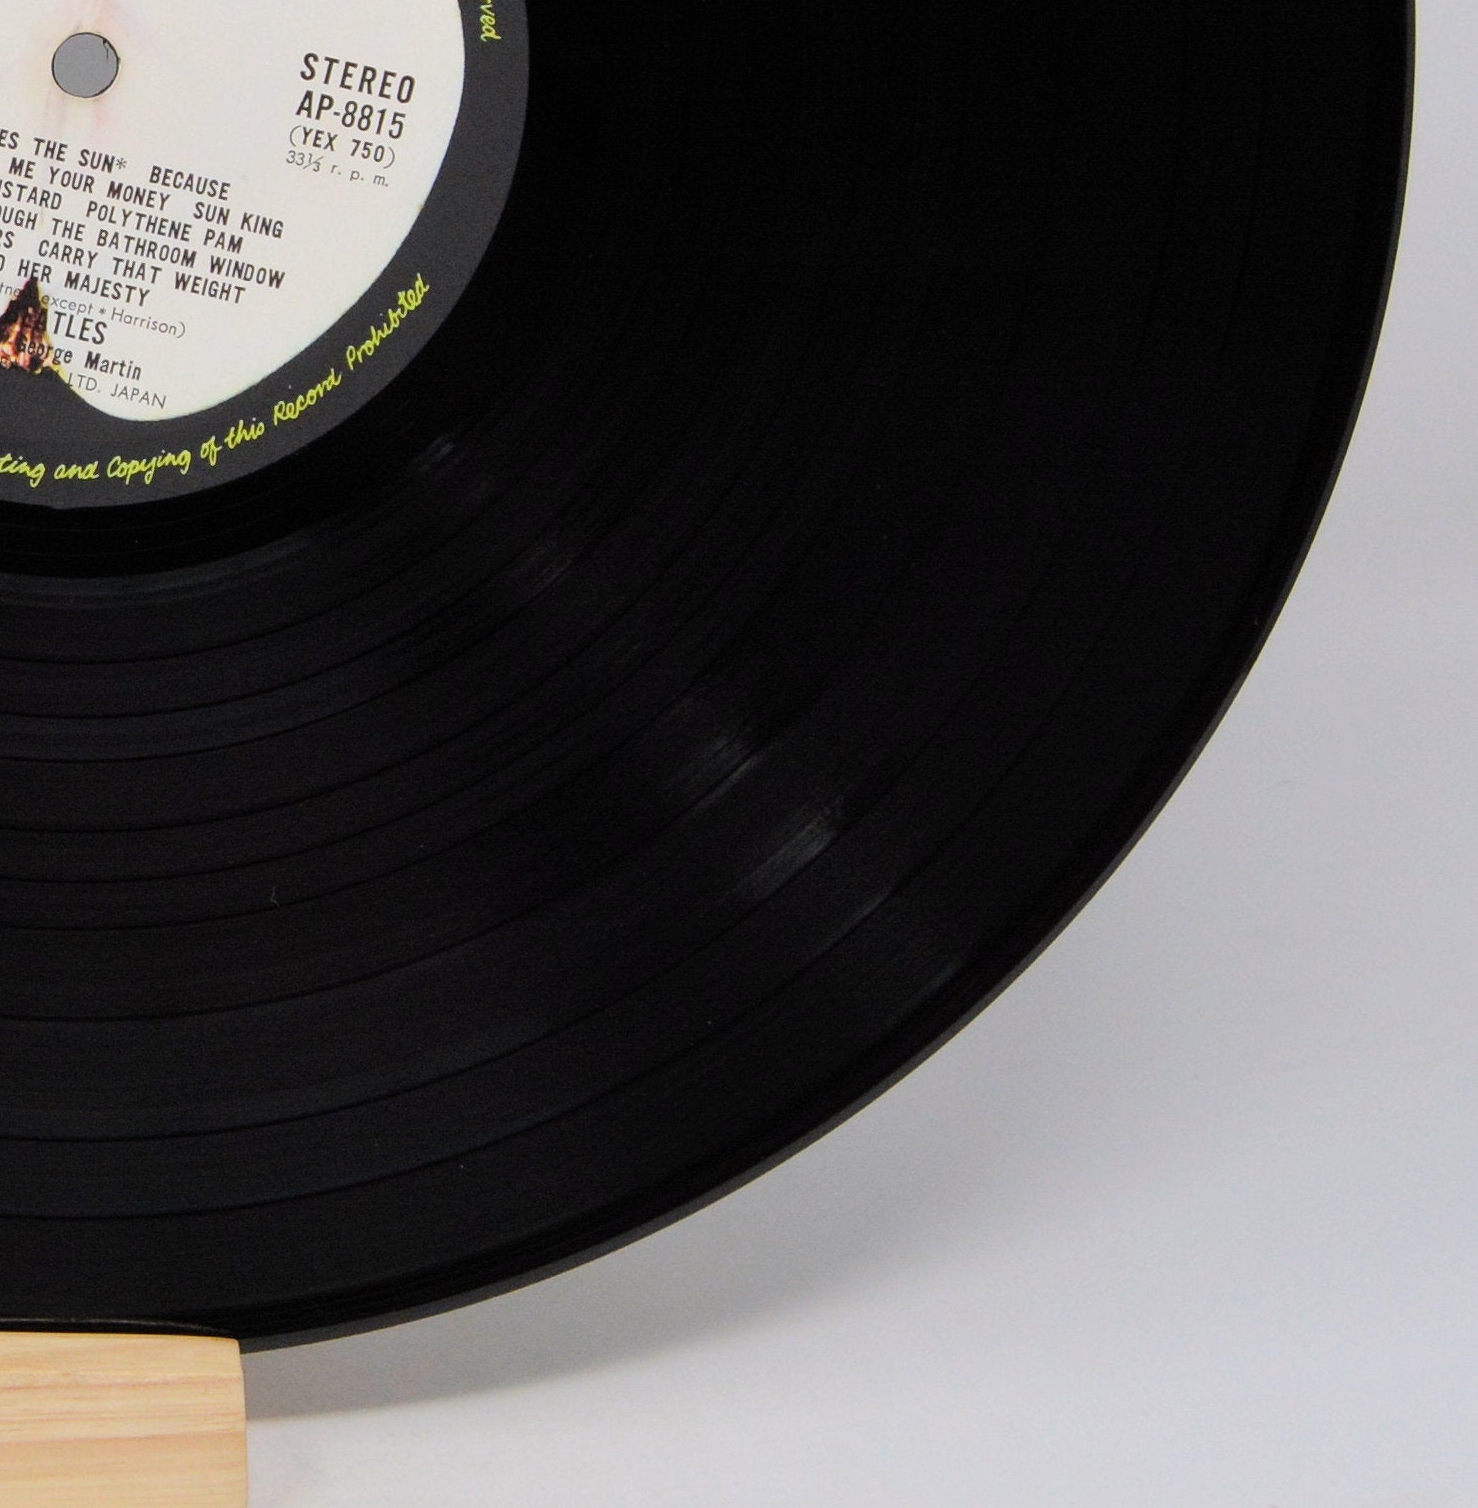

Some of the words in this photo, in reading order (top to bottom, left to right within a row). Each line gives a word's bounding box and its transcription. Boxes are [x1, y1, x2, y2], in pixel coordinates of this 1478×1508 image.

[299, 52, 416, 104] STEREO
[295, 89, 406, 140] AP-8815
[33, 137, 69, 162] THE
[148, 164, 231, 201] BECAUSE
[289, 124, 339, 152] (YEX
[350, 138, 396, 169] 750)
[8, 156, 36, 180] ME
[49, 165, 95, 194] YOUR
[106, 180, 171, 211] MONEY
[193, 201, 231, 226] SUN
[240, 211, 284, 239] KING
[51, 217, 86, 242] THE
[96, 228, 197, 269] BATHROOM
[209, 255, 286, 289] WINDOW
[85, 200, 193, 242] POLYTHENE
[203, 228, 244, 254] PAM
[16, 259, 53, 284] HER
[63, 270, 151, 307] MAJESTY
[38, 239, 99, 269] CARRY
[112, 256, 163, 284] THAT
[174, 271, 246, 304] WEIGHT
[37, 291, 94, 324] except
[110, 306, 186, 339] Harrison)
[16, 333, 74, 367] George
[84, 351, 141, 380] Martin
[53, 459, 99, 482] and
[107, 446, 192, 486] Copying
[200, 435, 222, 466] of
[225, 417, 266, 450] this
[273, 369, 342, 427] Record
[345, 272, 431, 370] Prohibited
[110, 383, 167, 409] JAPAN
